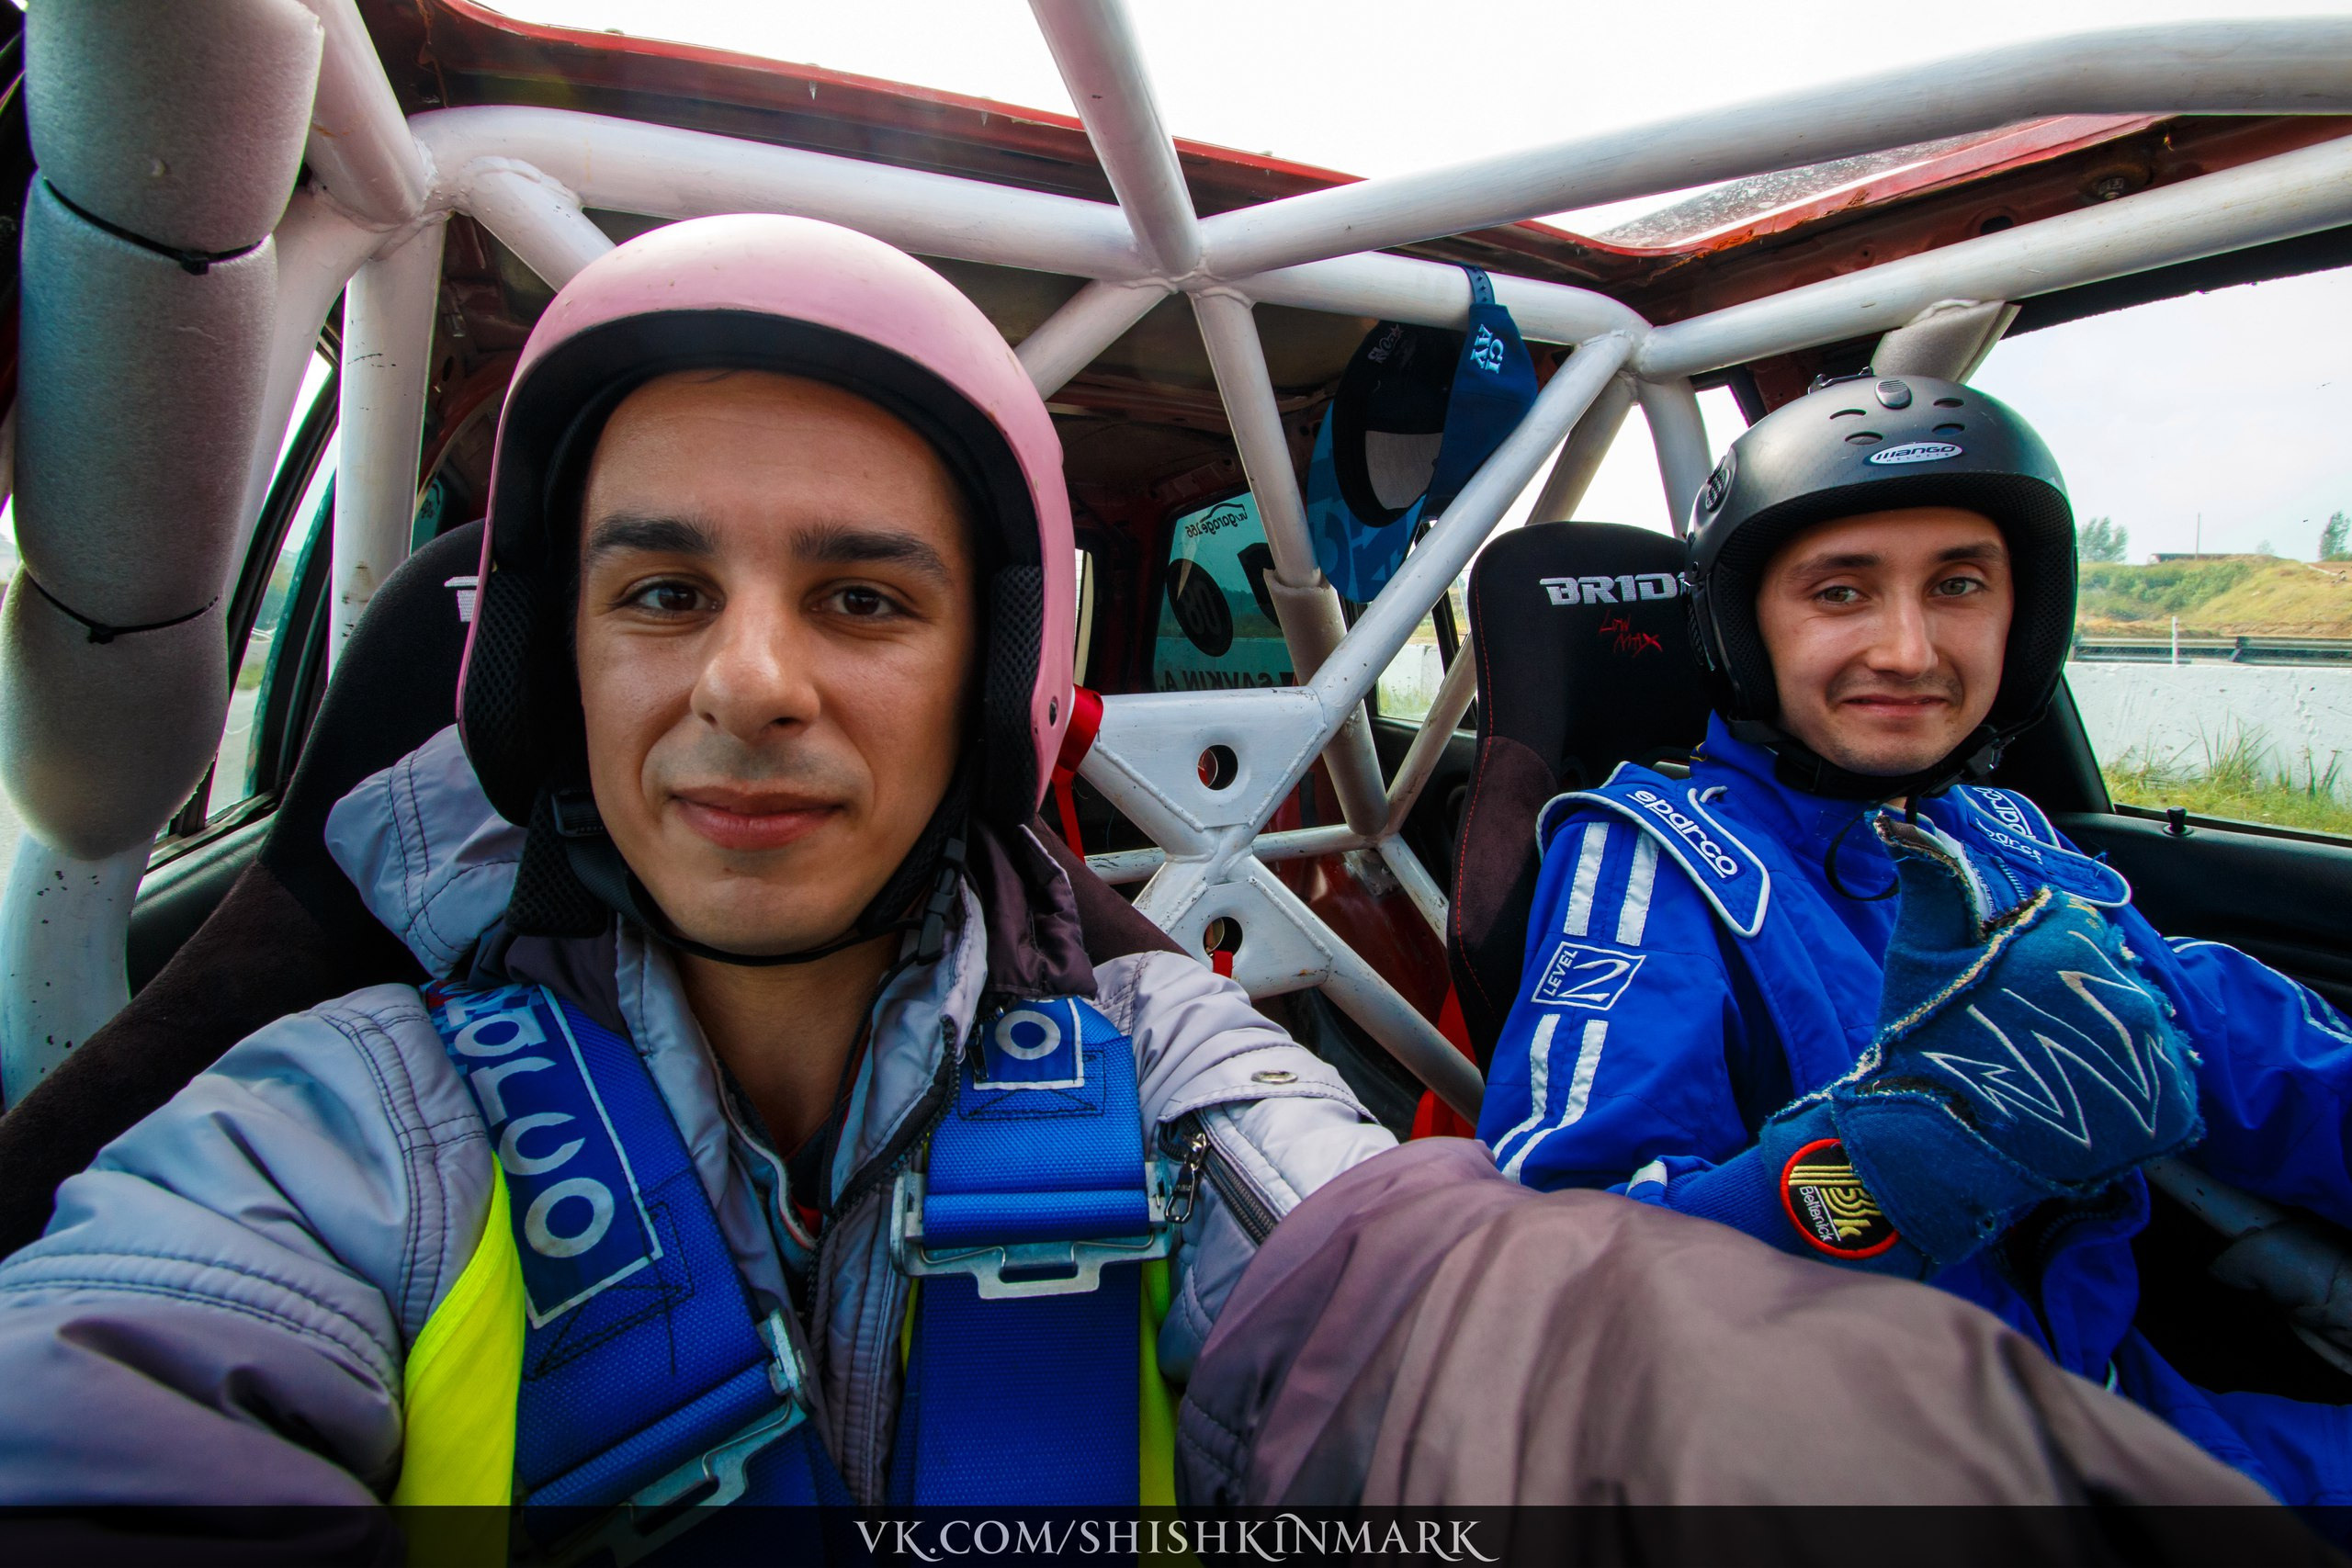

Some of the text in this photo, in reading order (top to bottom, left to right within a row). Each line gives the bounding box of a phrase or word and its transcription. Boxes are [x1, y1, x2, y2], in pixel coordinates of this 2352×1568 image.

[1539, 572, 1685, 606] BRID
[1634, 789, 1738, 876] sparco
[1972, 787, 2038, 840] parco
[1543, 950, 1578, 998] LEVEL
[1798, 1185, 1833, 1242] Beltenick
